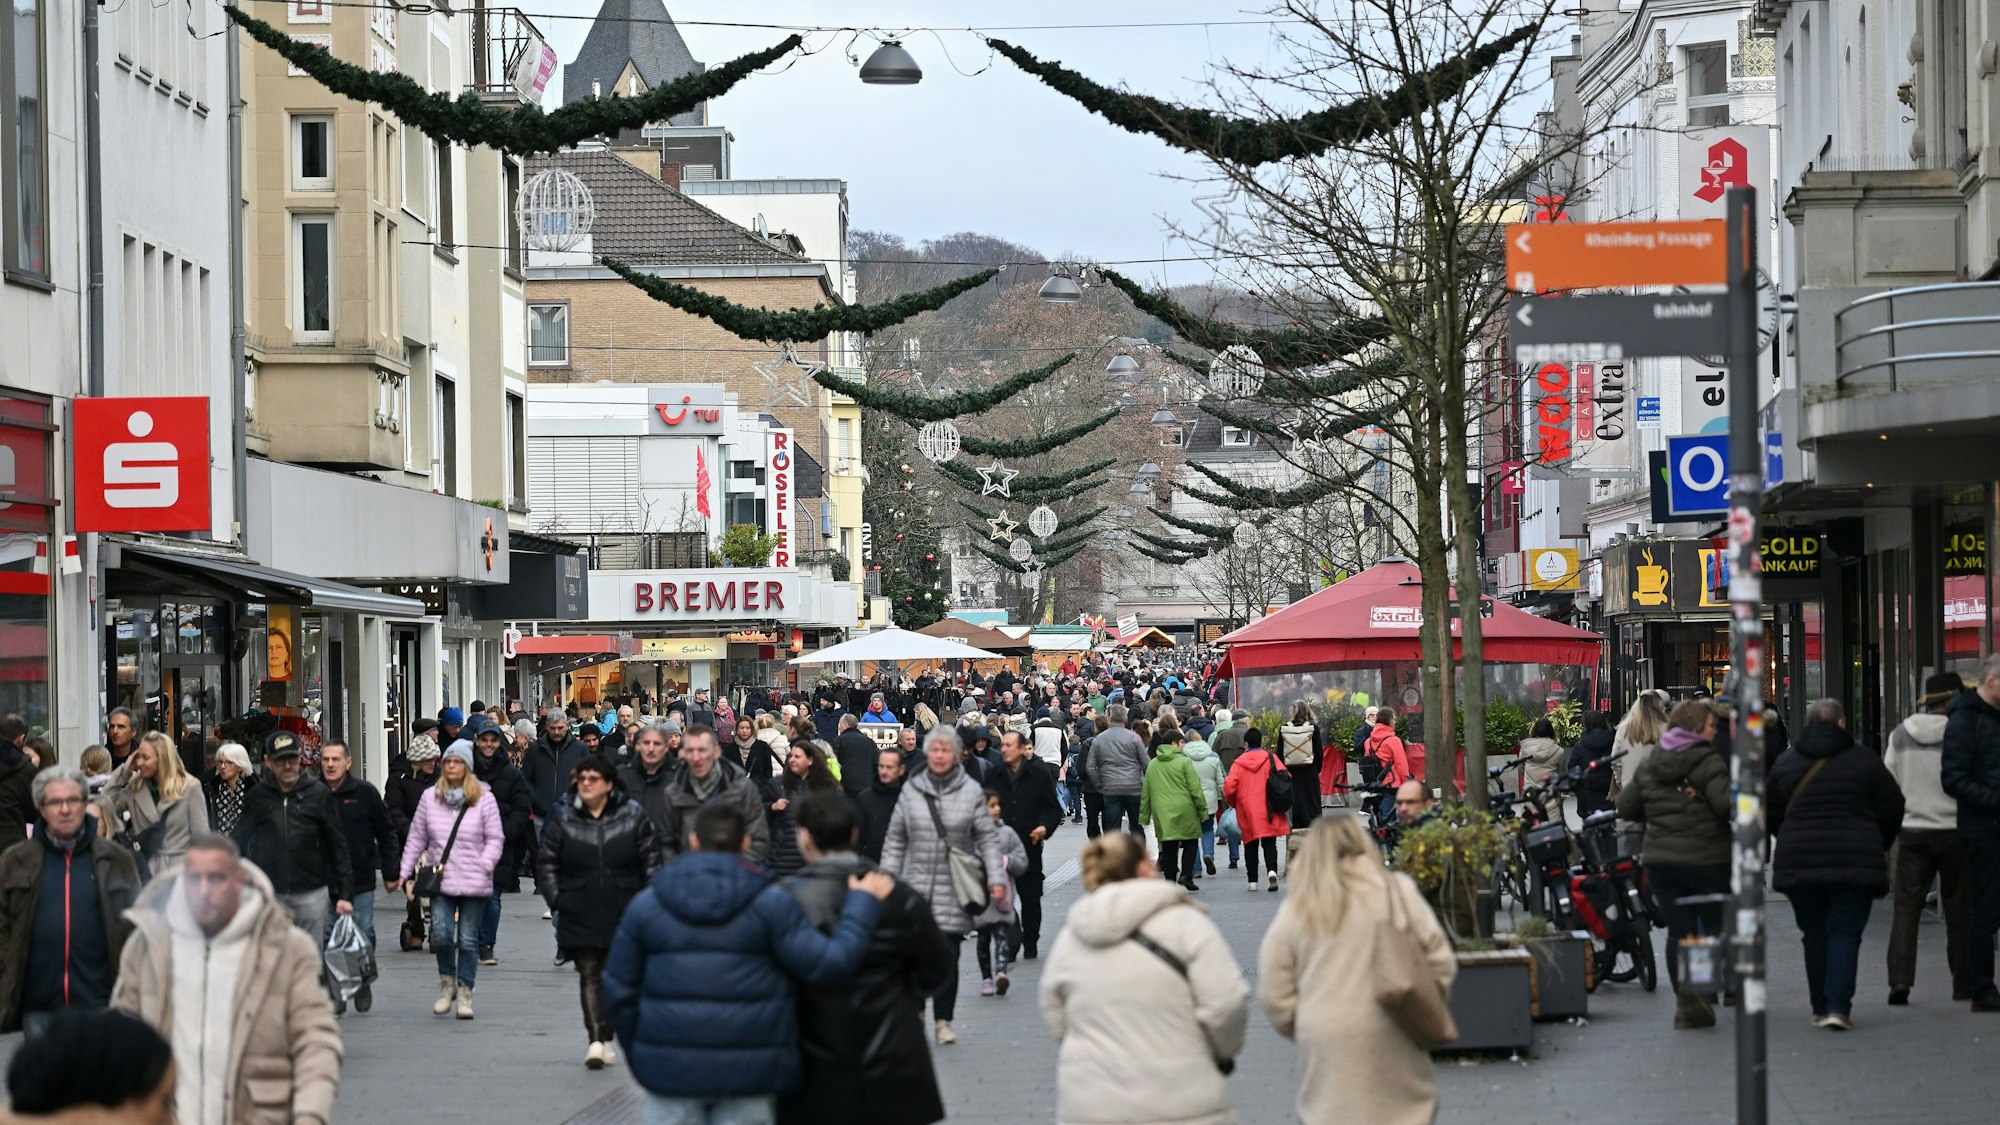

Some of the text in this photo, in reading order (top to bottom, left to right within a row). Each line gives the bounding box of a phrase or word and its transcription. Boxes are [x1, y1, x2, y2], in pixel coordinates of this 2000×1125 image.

[1658, 230, 1712, 248] Passage
[1653, 301, 1713, 319] Bahnhof
[1595, 361, 1624, 441] extra
[1695, 371, 1725, 406] el
[694, 409, 720, 427] TUI
[1537, 363, 1571, 464] WOO
[772, 432, 791, 568] RÖSELER
[634, 581, 786, 612] BREMER
[682, 644, 712, 653] Satch
